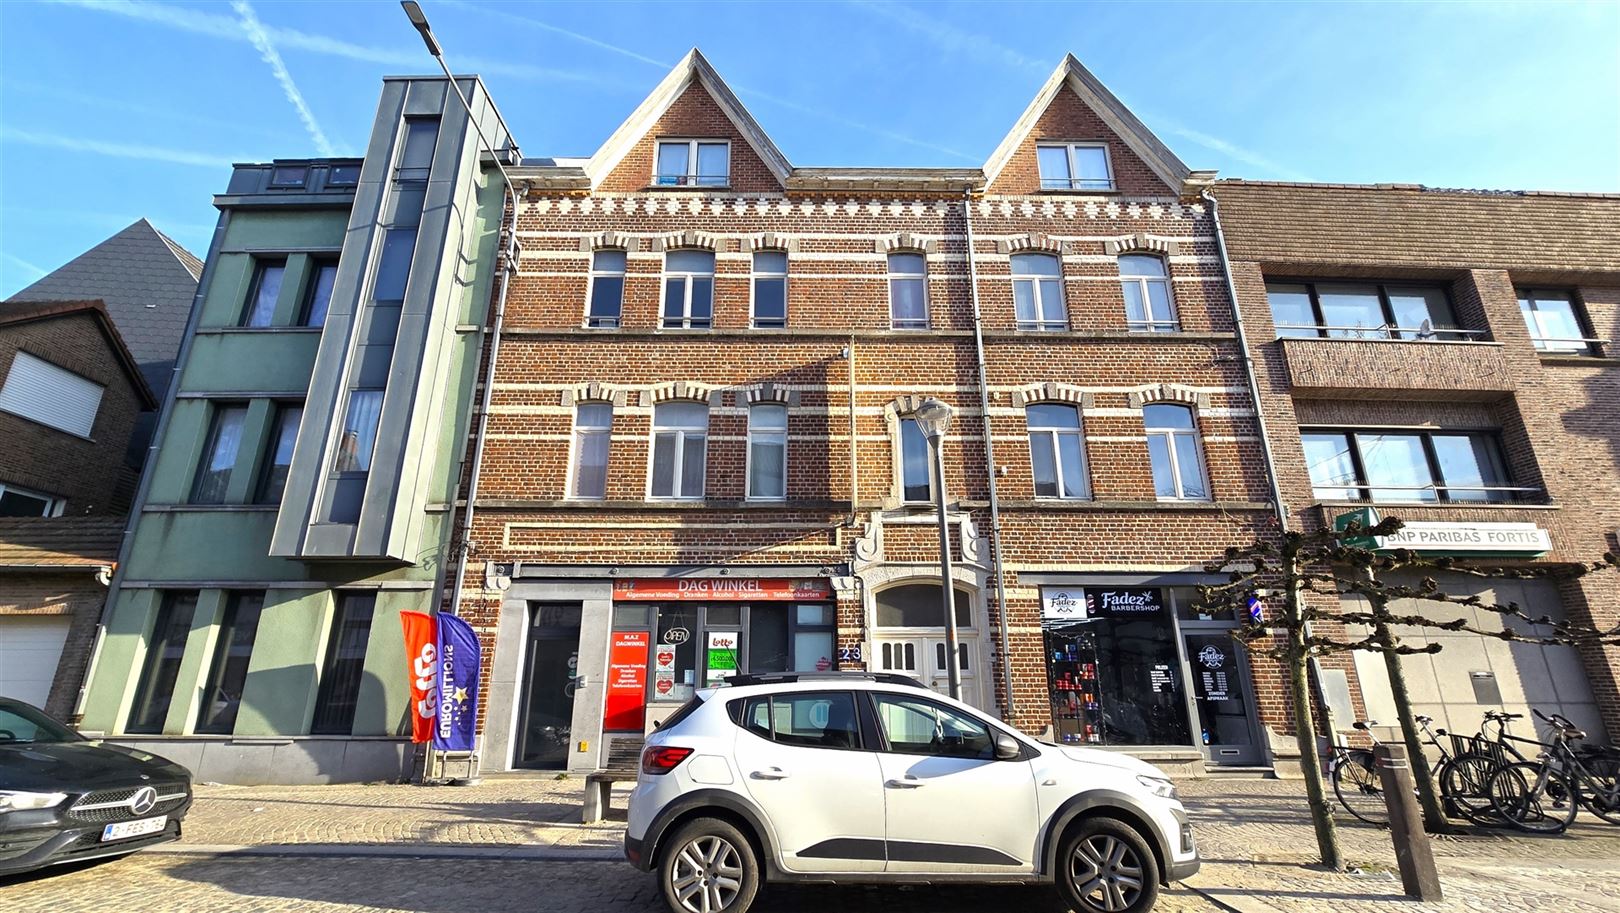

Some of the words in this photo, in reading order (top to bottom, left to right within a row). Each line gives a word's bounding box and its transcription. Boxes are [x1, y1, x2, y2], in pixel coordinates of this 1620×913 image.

[1387, 531, 1416, 543] BNP
[1420, 531, 1481, 543] PARIBAS
[1488, 531, 1540, 543] FORTIS
[678, 580, 708, 592] DAG
[711, 580, 763, 592] WINKEL
[1051, 597, 1077, 608] Fadez
[1101, 591, 1145, 609] Fadez
[1111, 605, 1161, 613] BARBERSHOP
[665, 631, 688, 641] OPEN
[1198, 651, 1225, 663] Fadez
